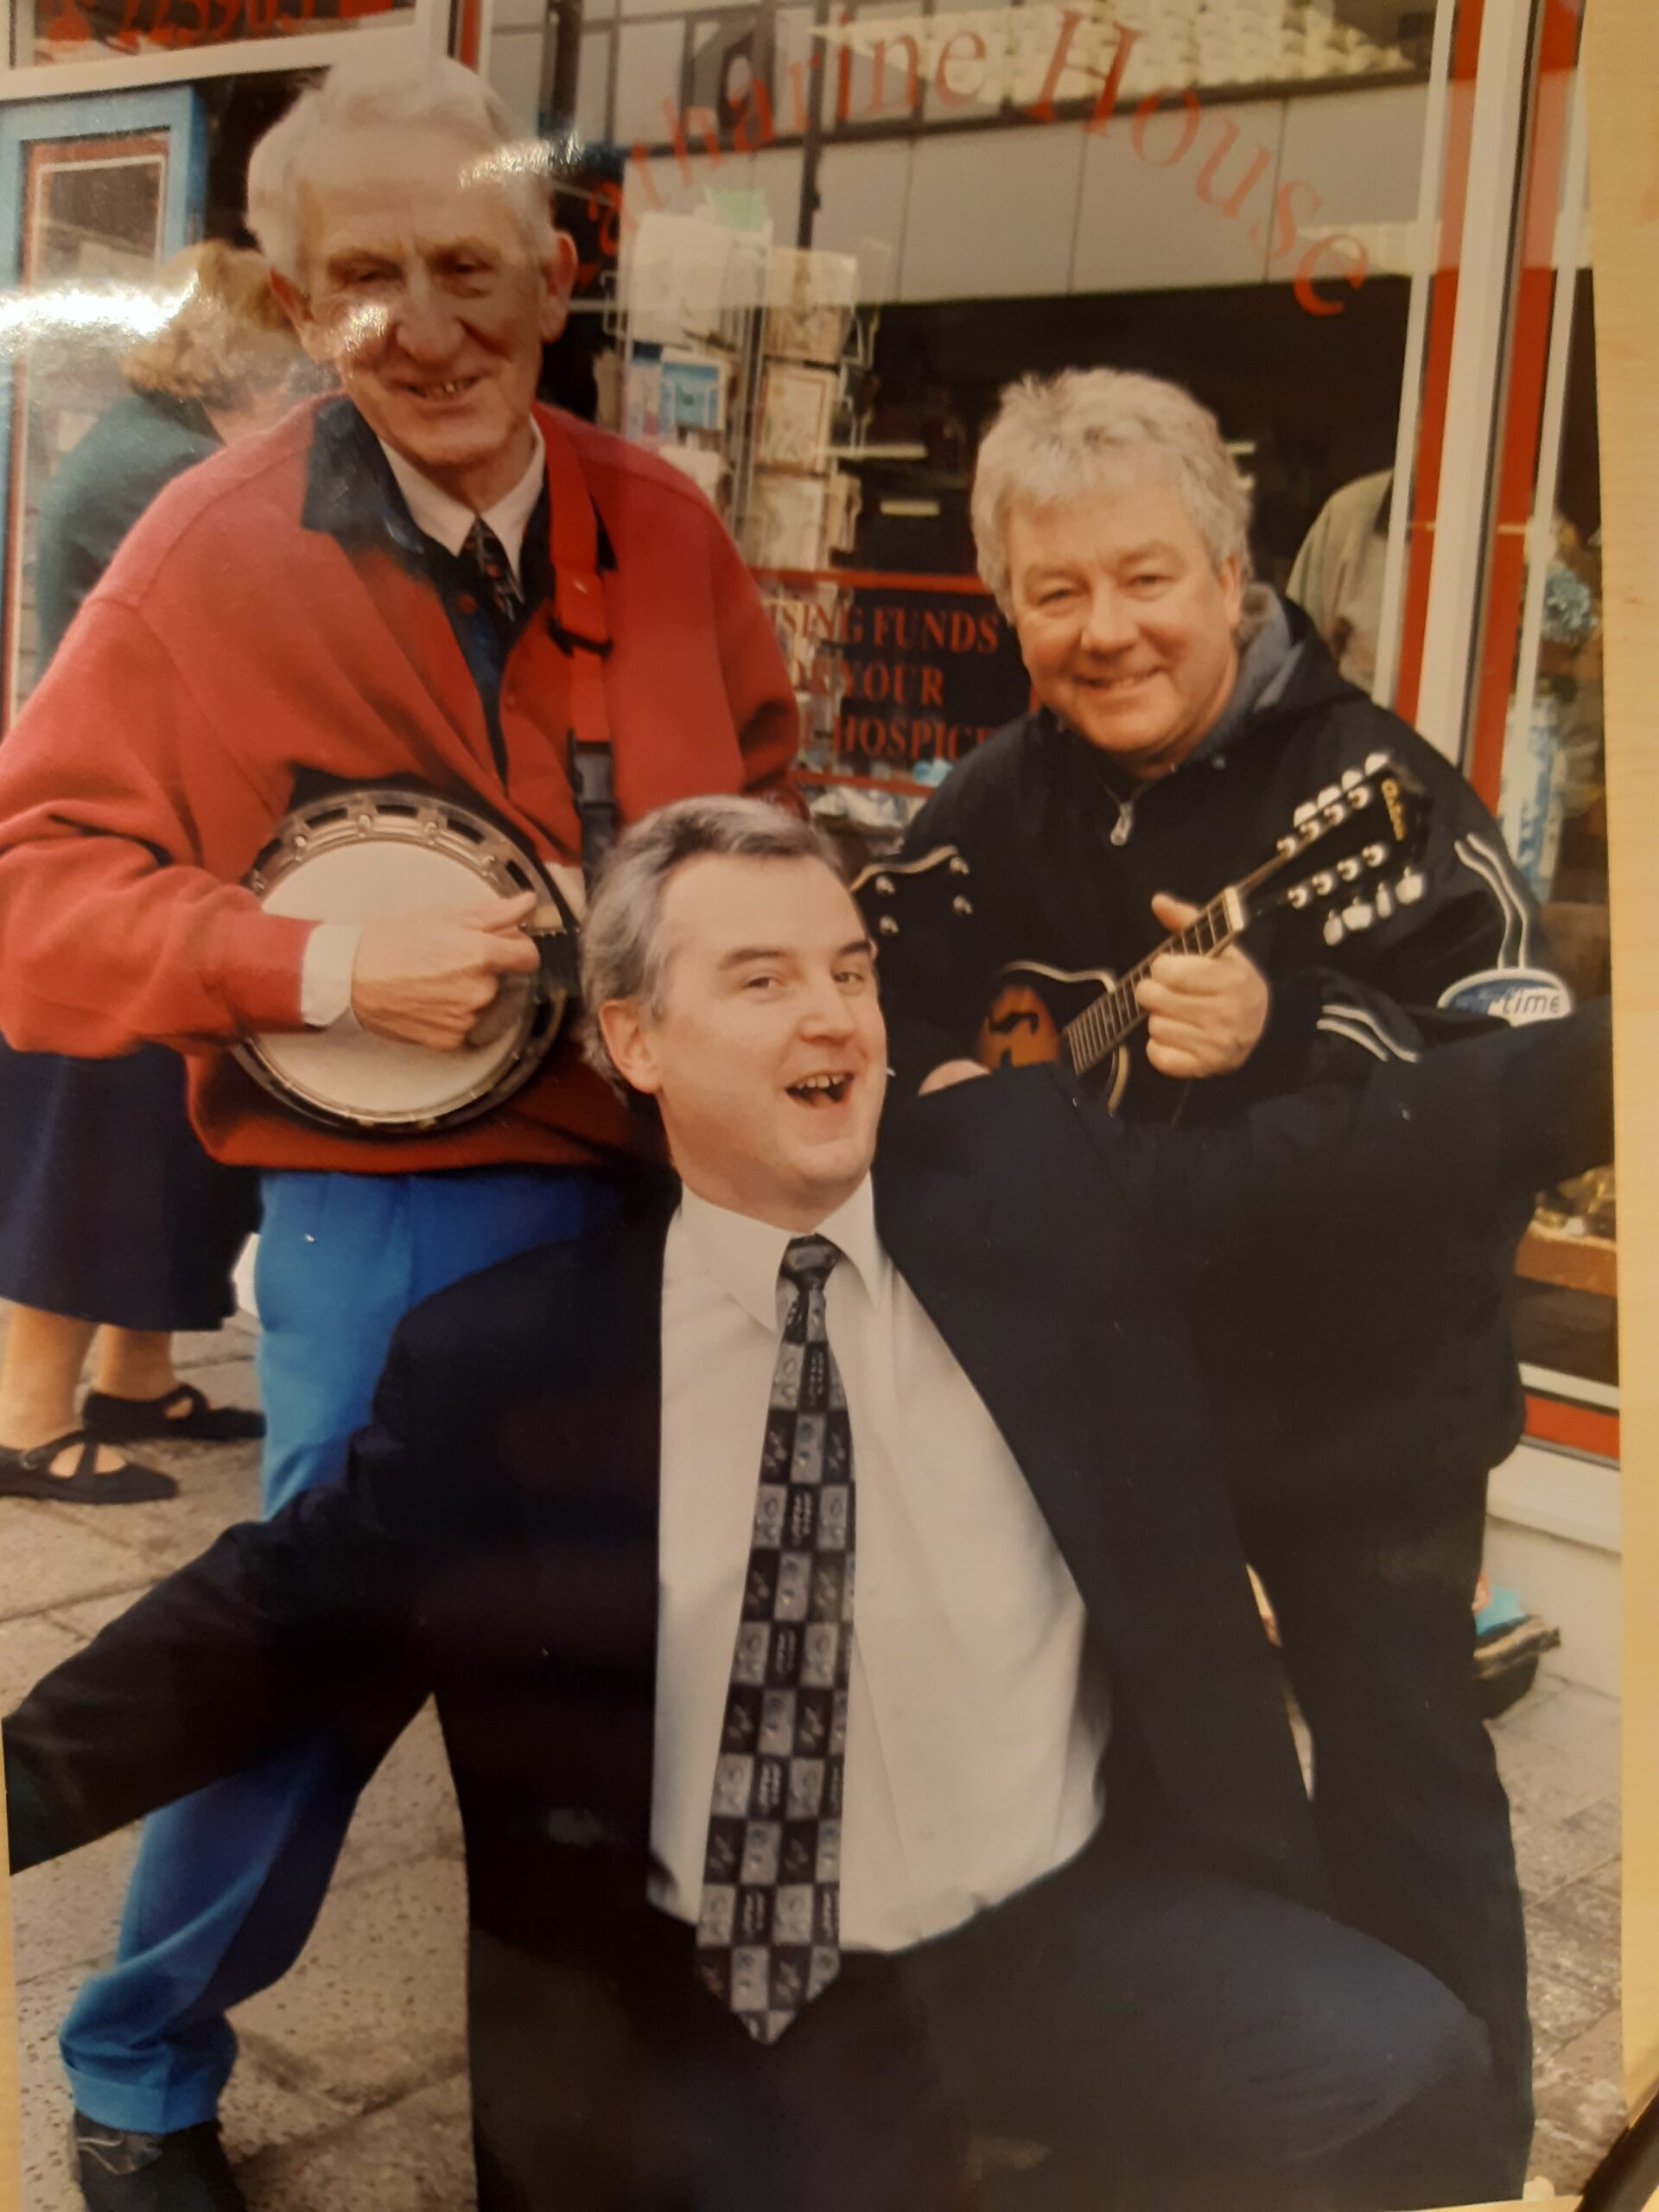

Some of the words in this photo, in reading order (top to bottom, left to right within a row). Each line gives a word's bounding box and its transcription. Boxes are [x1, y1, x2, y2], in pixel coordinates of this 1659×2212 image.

[579, 11, 987, 288] atharine
[1021, 10, 1369, 316] House
[873, 607, 999, 654] FUNDS
[839, 658, 945, 707] YOUR
